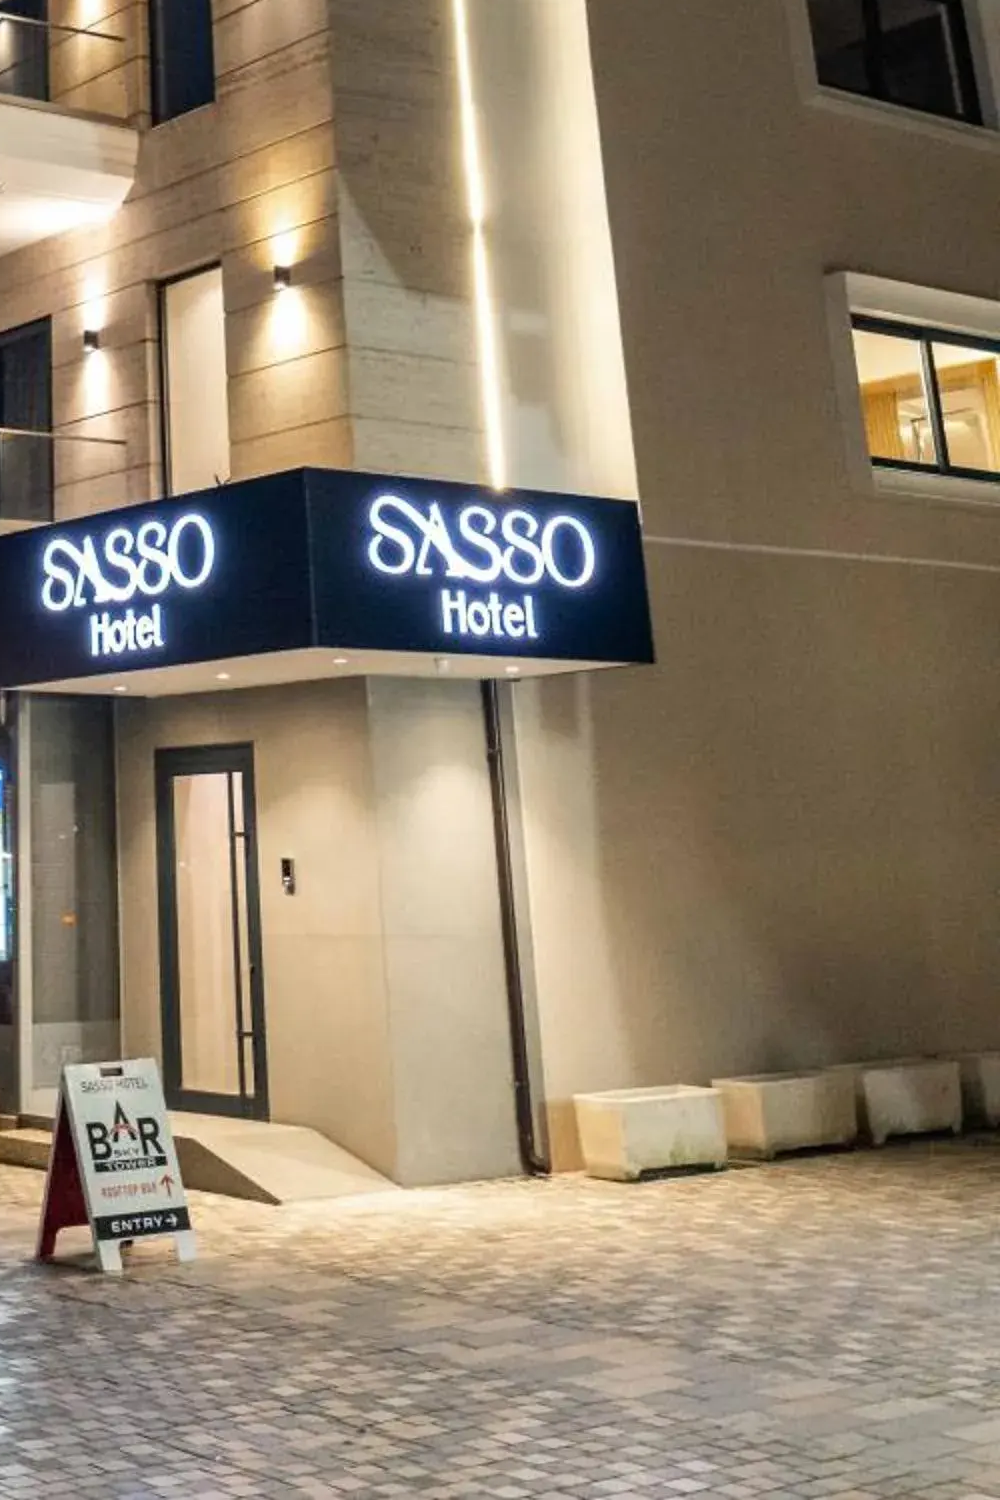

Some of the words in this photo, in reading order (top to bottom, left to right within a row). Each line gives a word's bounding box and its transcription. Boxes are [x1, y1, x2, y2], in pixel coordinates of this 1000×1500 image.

[42, 514, 215, 611] SASSO
[366, 495, 595, 587] SASSO
[89, 603, 165, 657] Hotel
[441, 589, 538, 638] Hotel
[116, 1076, 149, 1090] HOTEL
[86, 1100, 166, 1160] BAR
[111, 1213, 164, 1233] ENTRY
